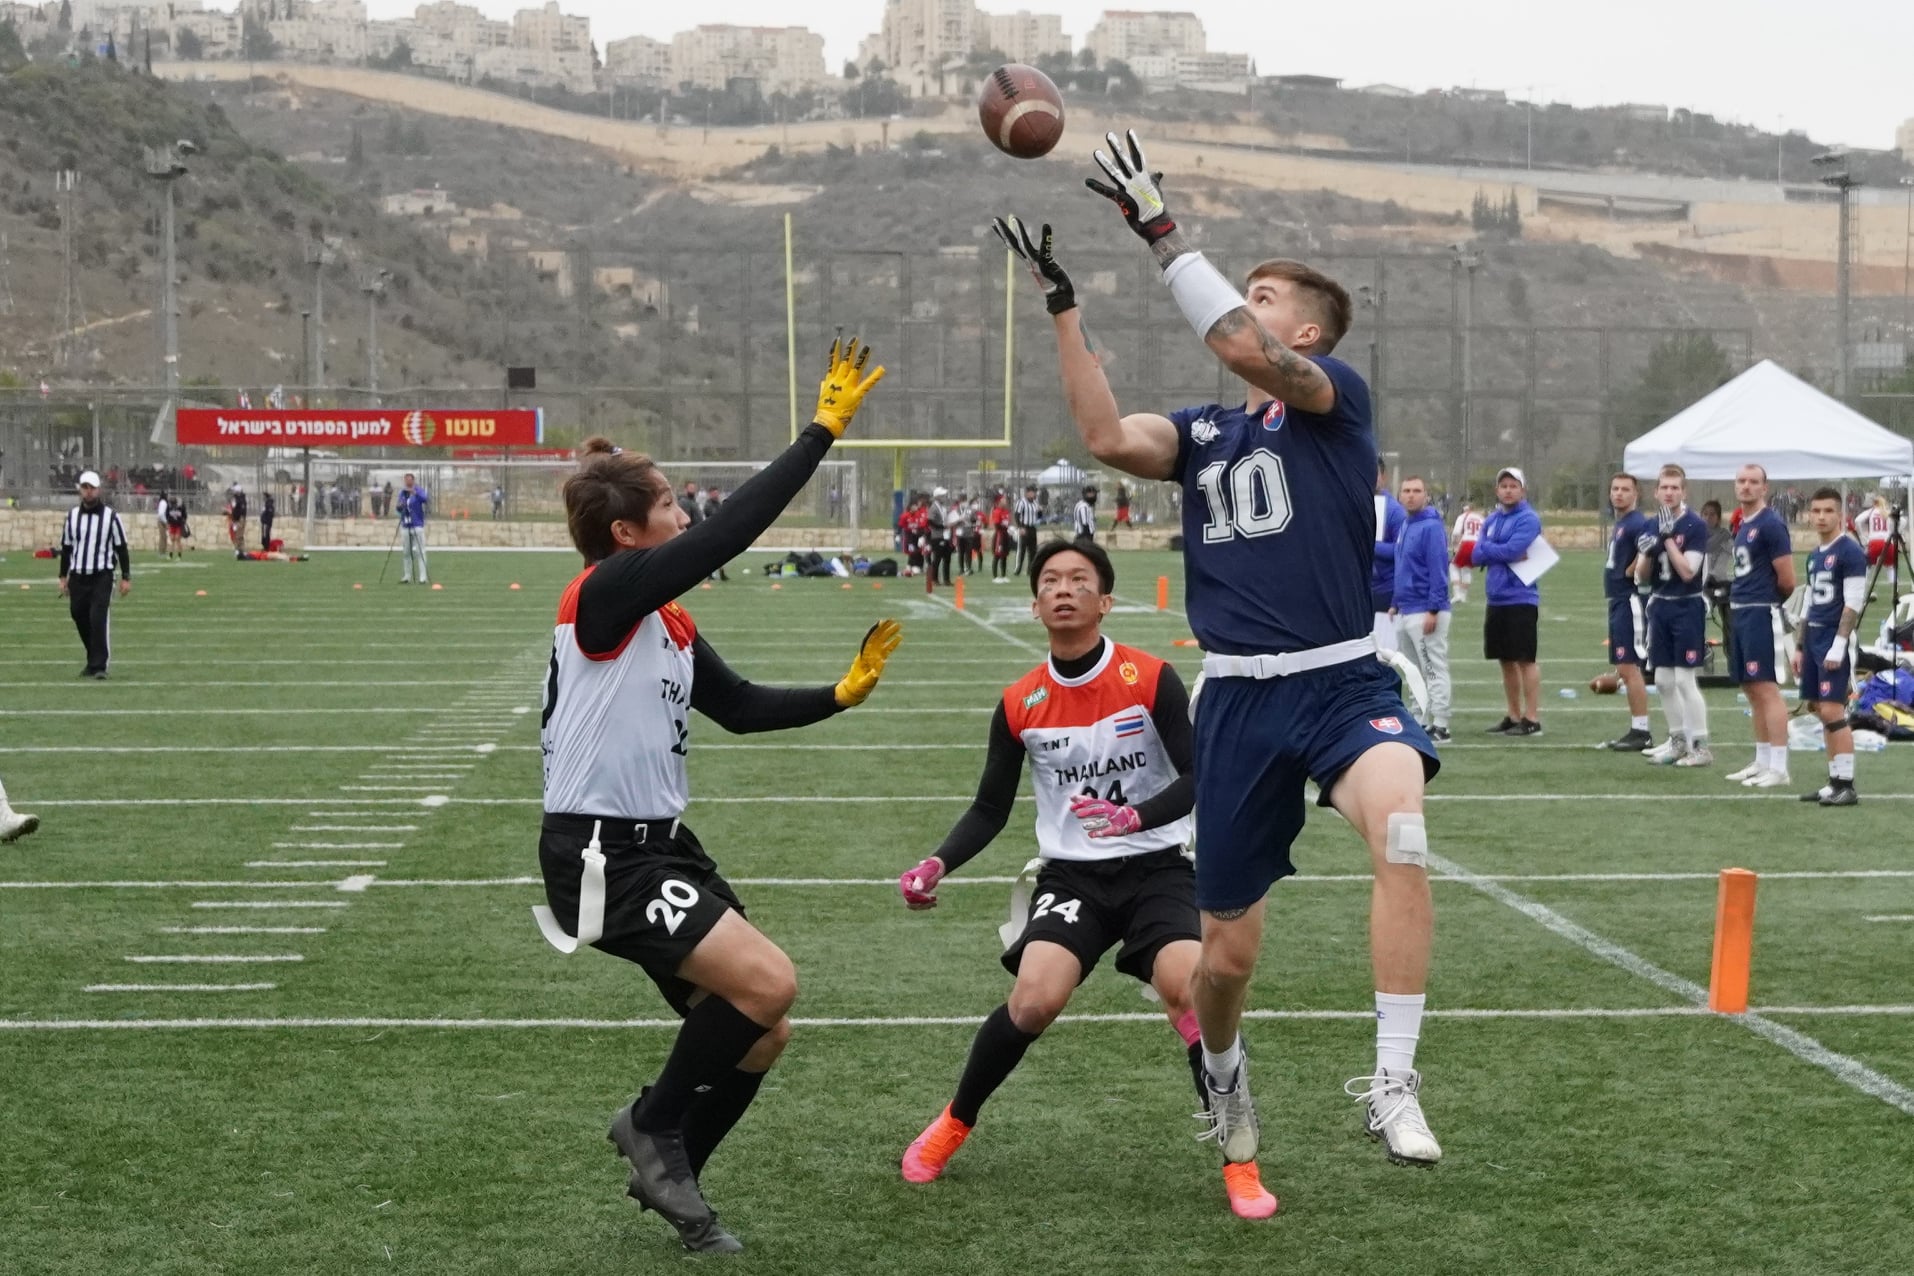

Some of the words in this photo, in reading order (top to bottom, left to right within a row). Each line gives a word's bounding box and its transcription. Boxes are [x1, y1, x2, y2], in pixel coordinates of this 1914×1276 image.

[217, 417, 282, 435] בישראל
[285, 419, 348, 435] הספורט
[351, 418, 391, 439] למען
[445, 418, 496, 436] טוטו
[1197, 447, 1293, 544] 10
[1055, 751, 1147, 786] THAILAND
[645, 879, 699, 936] 20
[1031, 892, 1082, 924] 24
